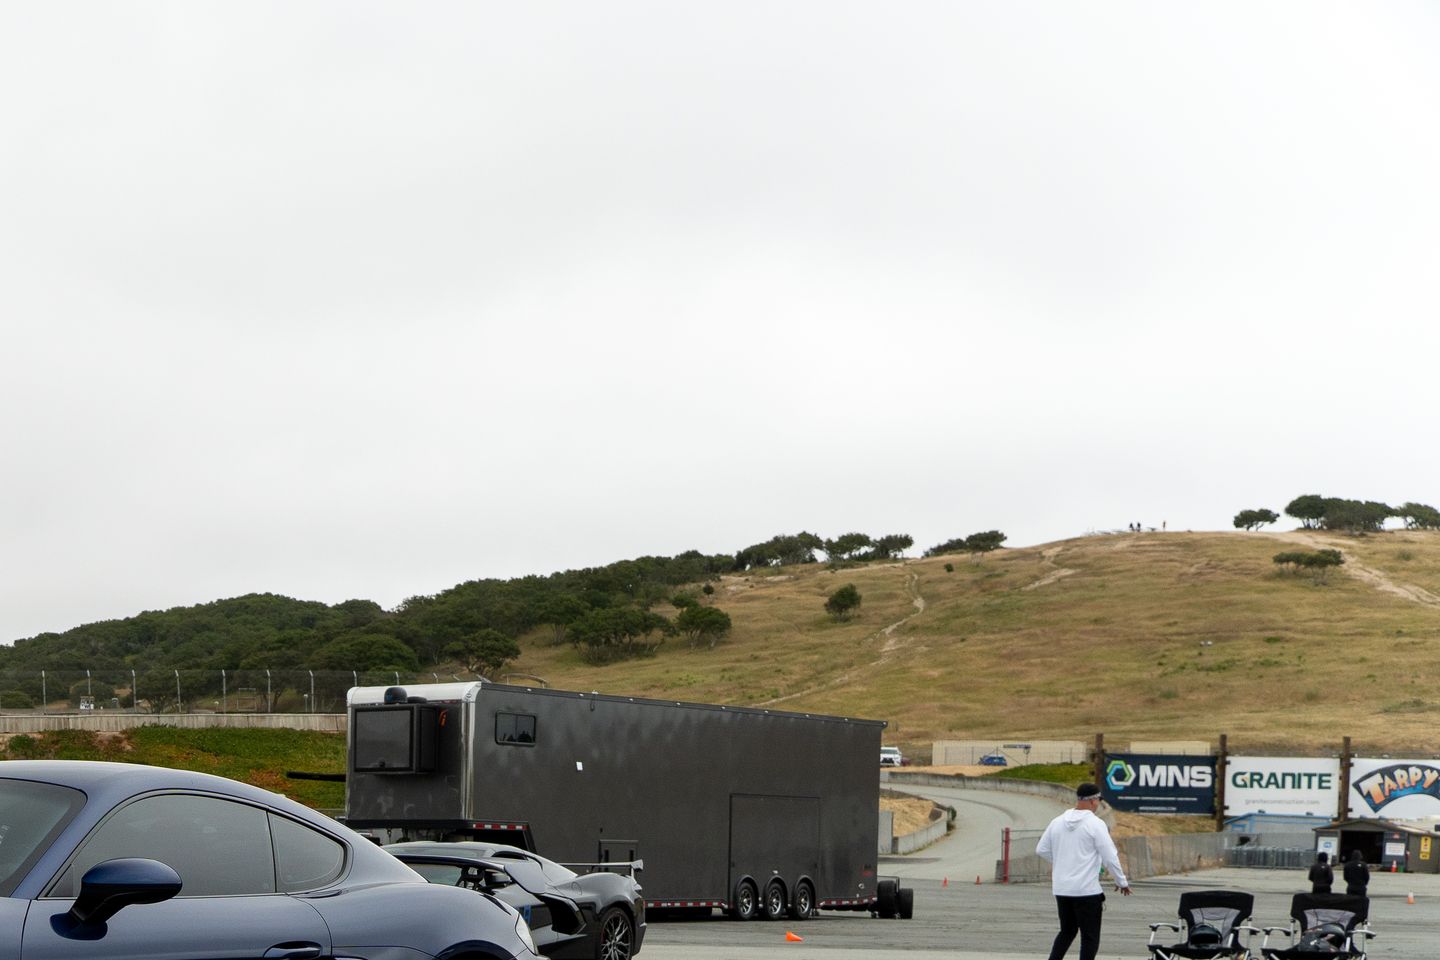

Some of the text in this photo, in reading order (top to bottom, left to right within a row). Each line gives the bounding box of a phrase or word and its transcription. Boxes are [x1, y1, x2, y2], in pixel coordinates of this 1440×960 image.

[1139, 765, 1212, 787] MNS
[1231, 771, 1332, 789] GRANITE
[1358, 766, 1440, 804] TARPY
